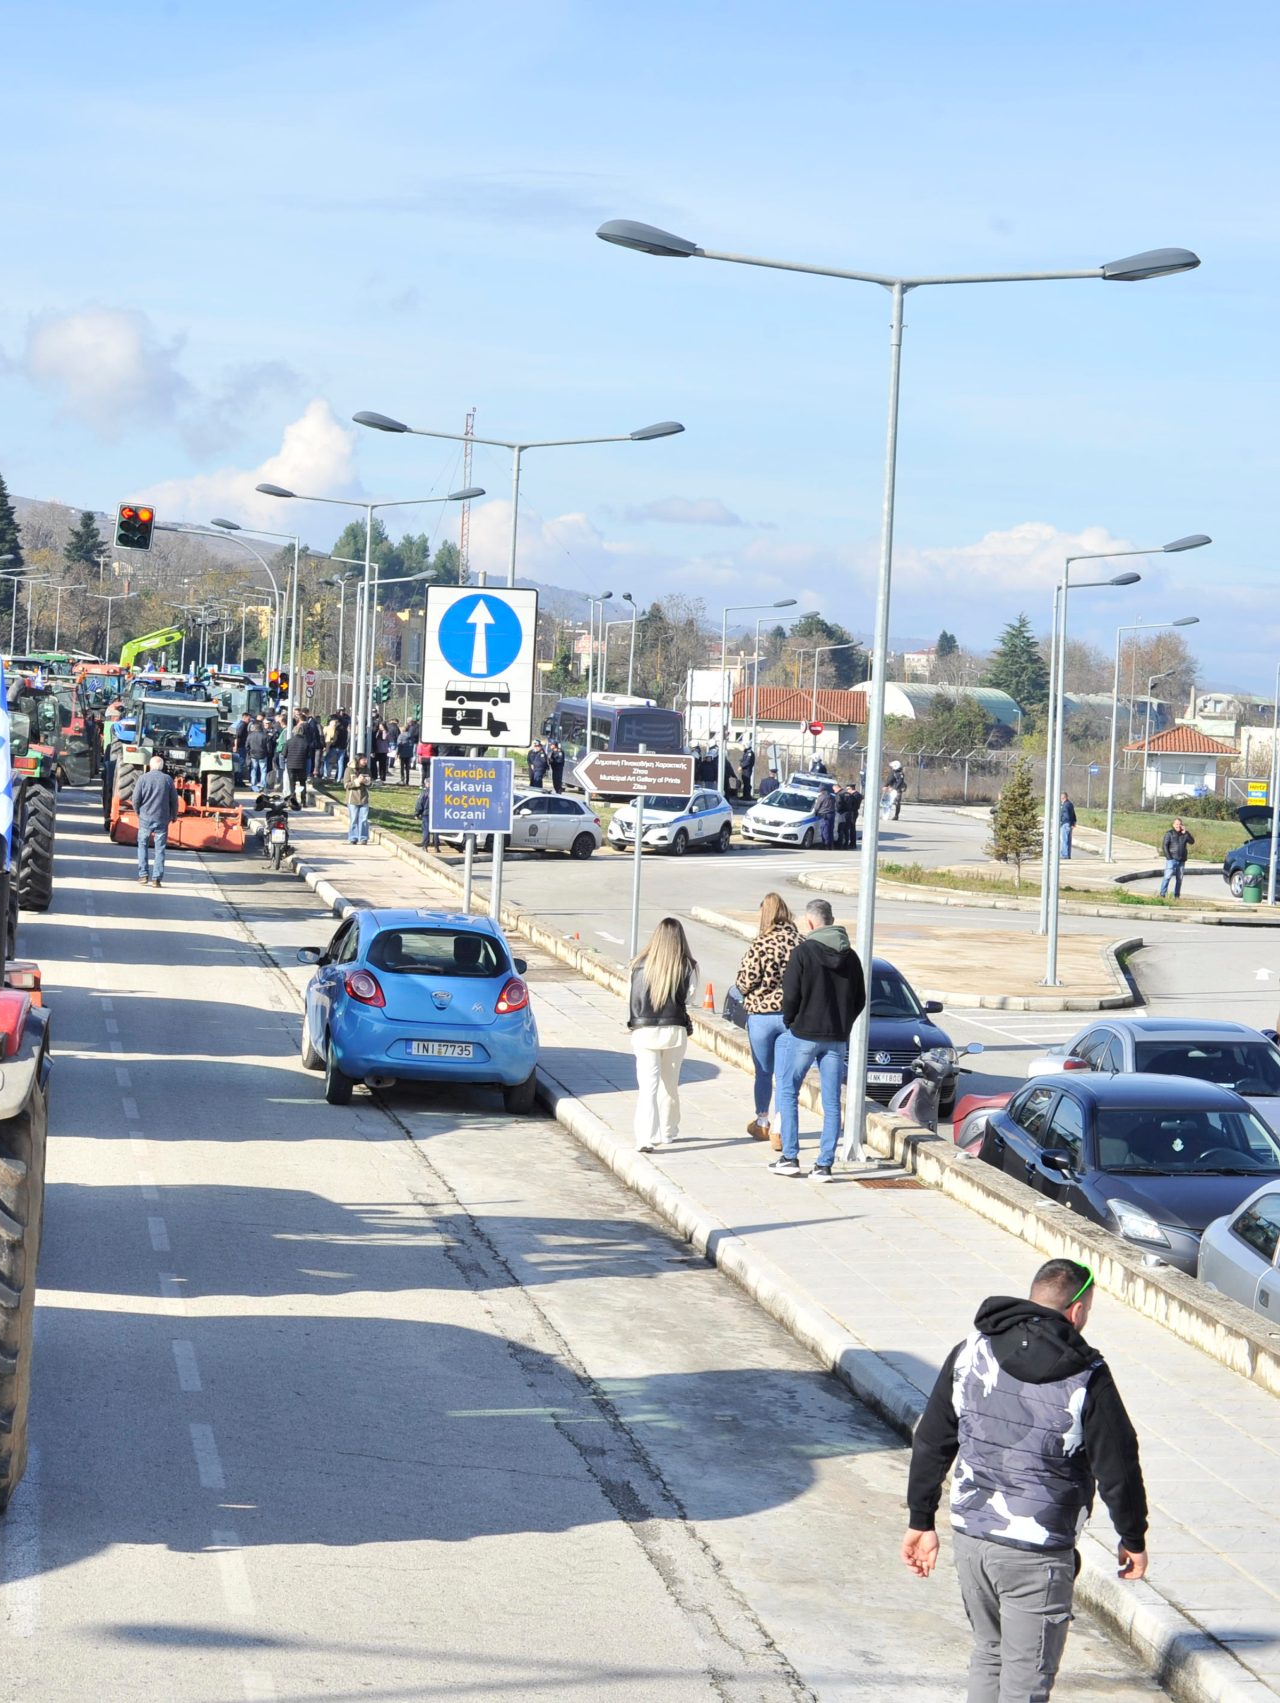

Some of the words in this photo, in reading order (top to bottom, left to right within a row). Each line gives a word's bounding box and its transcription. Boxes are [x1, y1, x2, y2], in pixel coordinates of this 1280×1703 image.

[444, 767, 496, 780] Κακαβιά
[600, 774, 626, 782] Municipal
[636, 775, 657, 784] Gallery
[444, 780, 493, 792] Kakavia
[444, 794, 490, 808] Κοζάνη
[444, 808, 486, 820] Kozani
[442, 1044, 471, 1056] 7735
